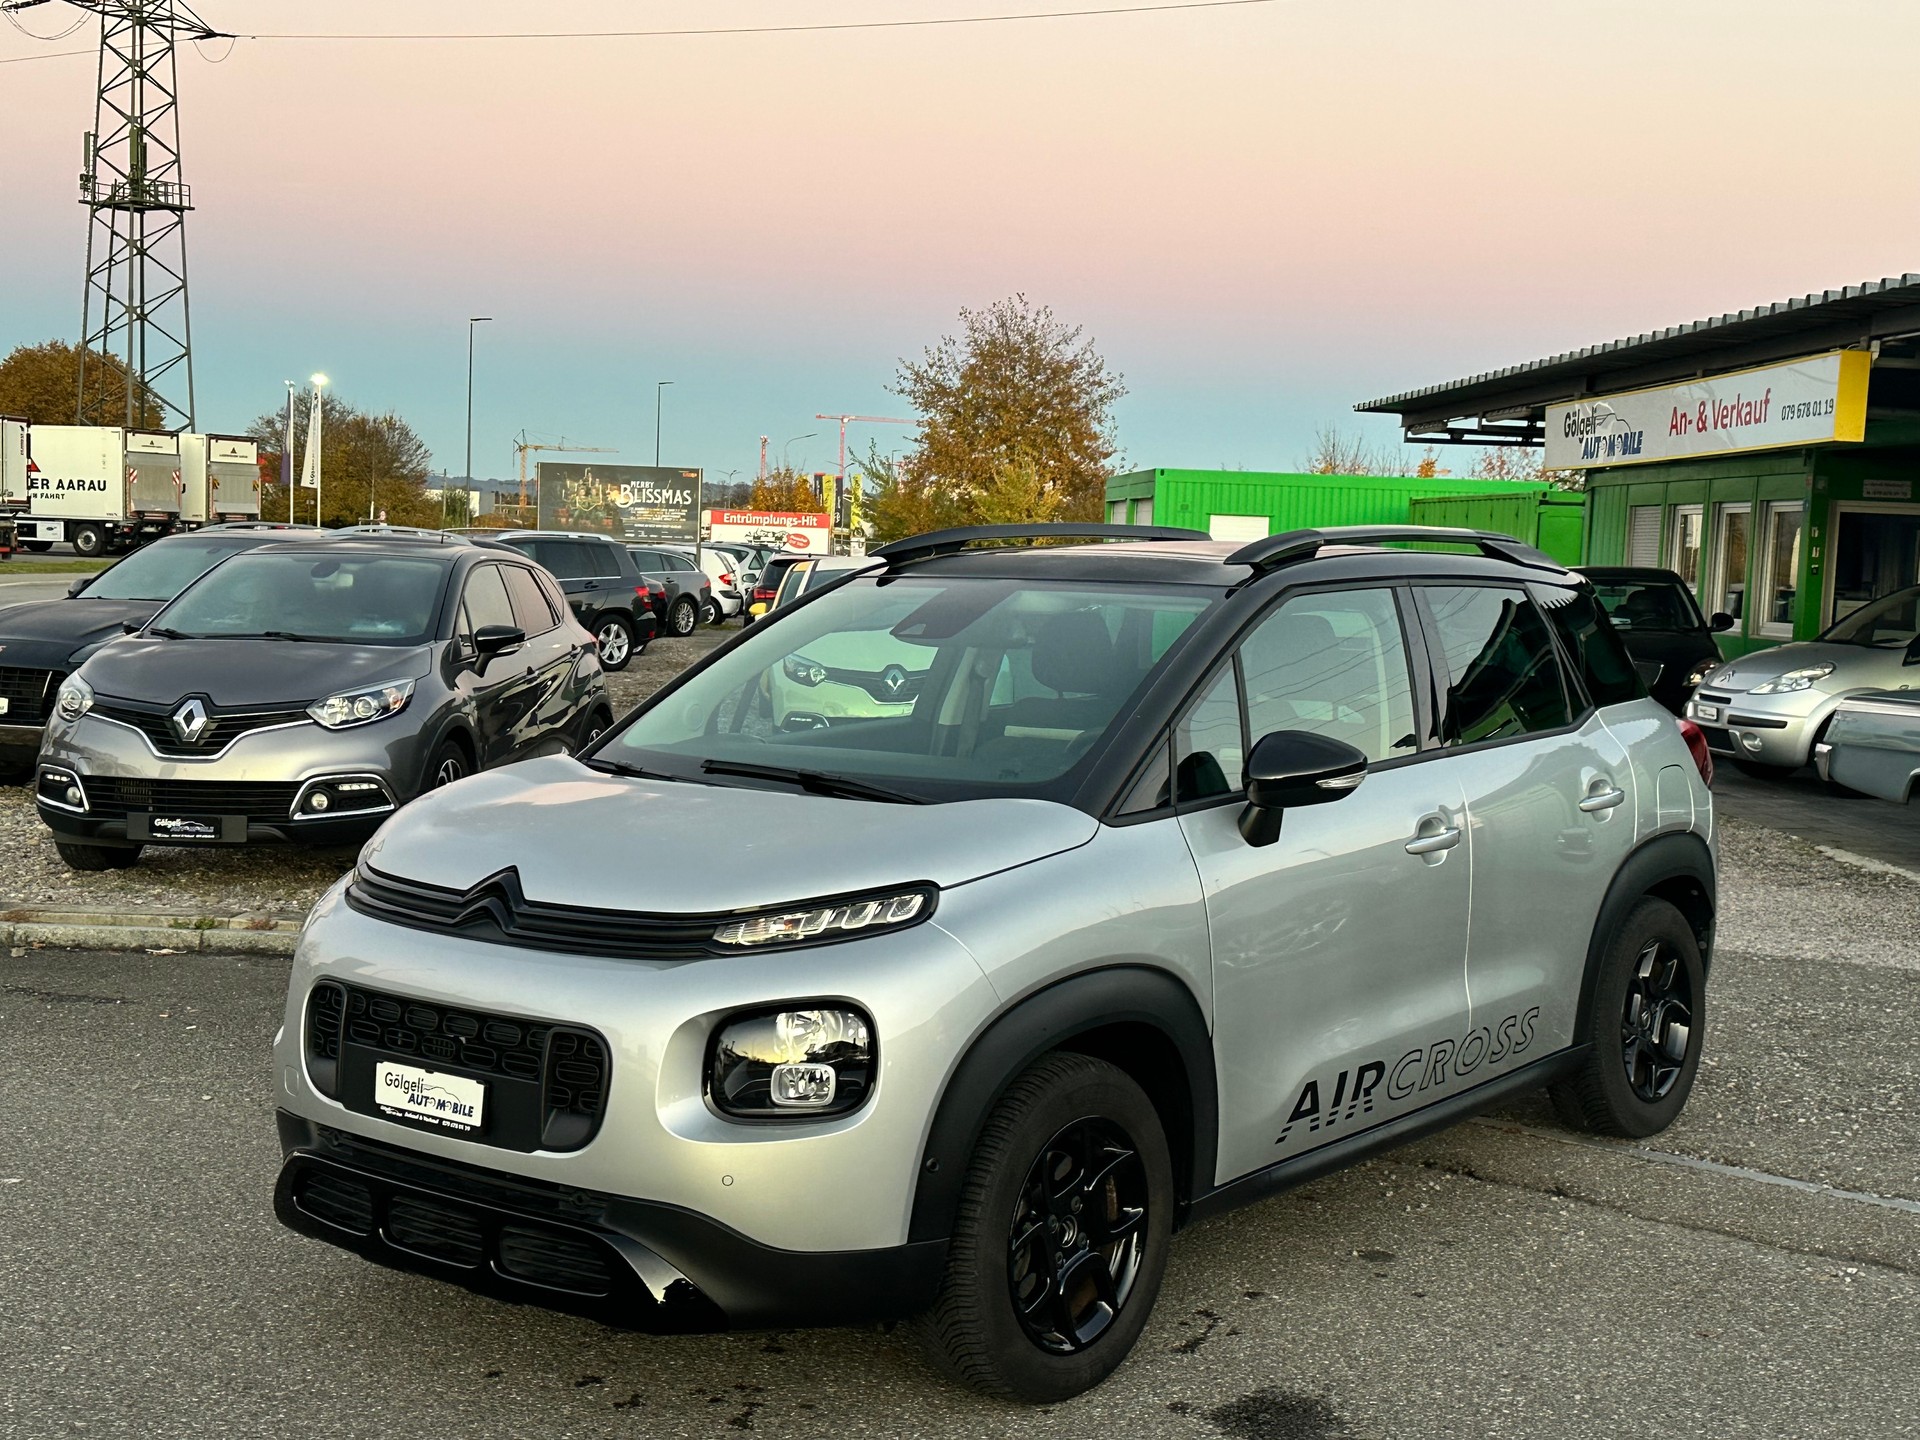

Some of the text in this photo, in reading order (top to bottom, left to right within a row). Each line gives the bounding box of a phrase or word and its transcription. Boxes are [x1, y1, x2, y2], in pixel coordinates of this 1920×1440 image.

[1669, 388, 1772, 437] An- & Verkauf
[1781, 398, 1834, 421] 079 678 01 19
[1564, 406, 1597, 444] Gölgeli
[1582, 431, 1643, 460] AUTOMOBILE
[56, 479, 107, 491] AARAU
[615, 483, 692, 508] BLISSMAS
[723, 512, 818, 527] Entrümplungs-Hit
[385, 1072, 424, 1095] Gölgeli
[1275, 1006, 1540, 1145] AIRCROSS
[407, 1093, 475, 1118] AUTOMOBILE
